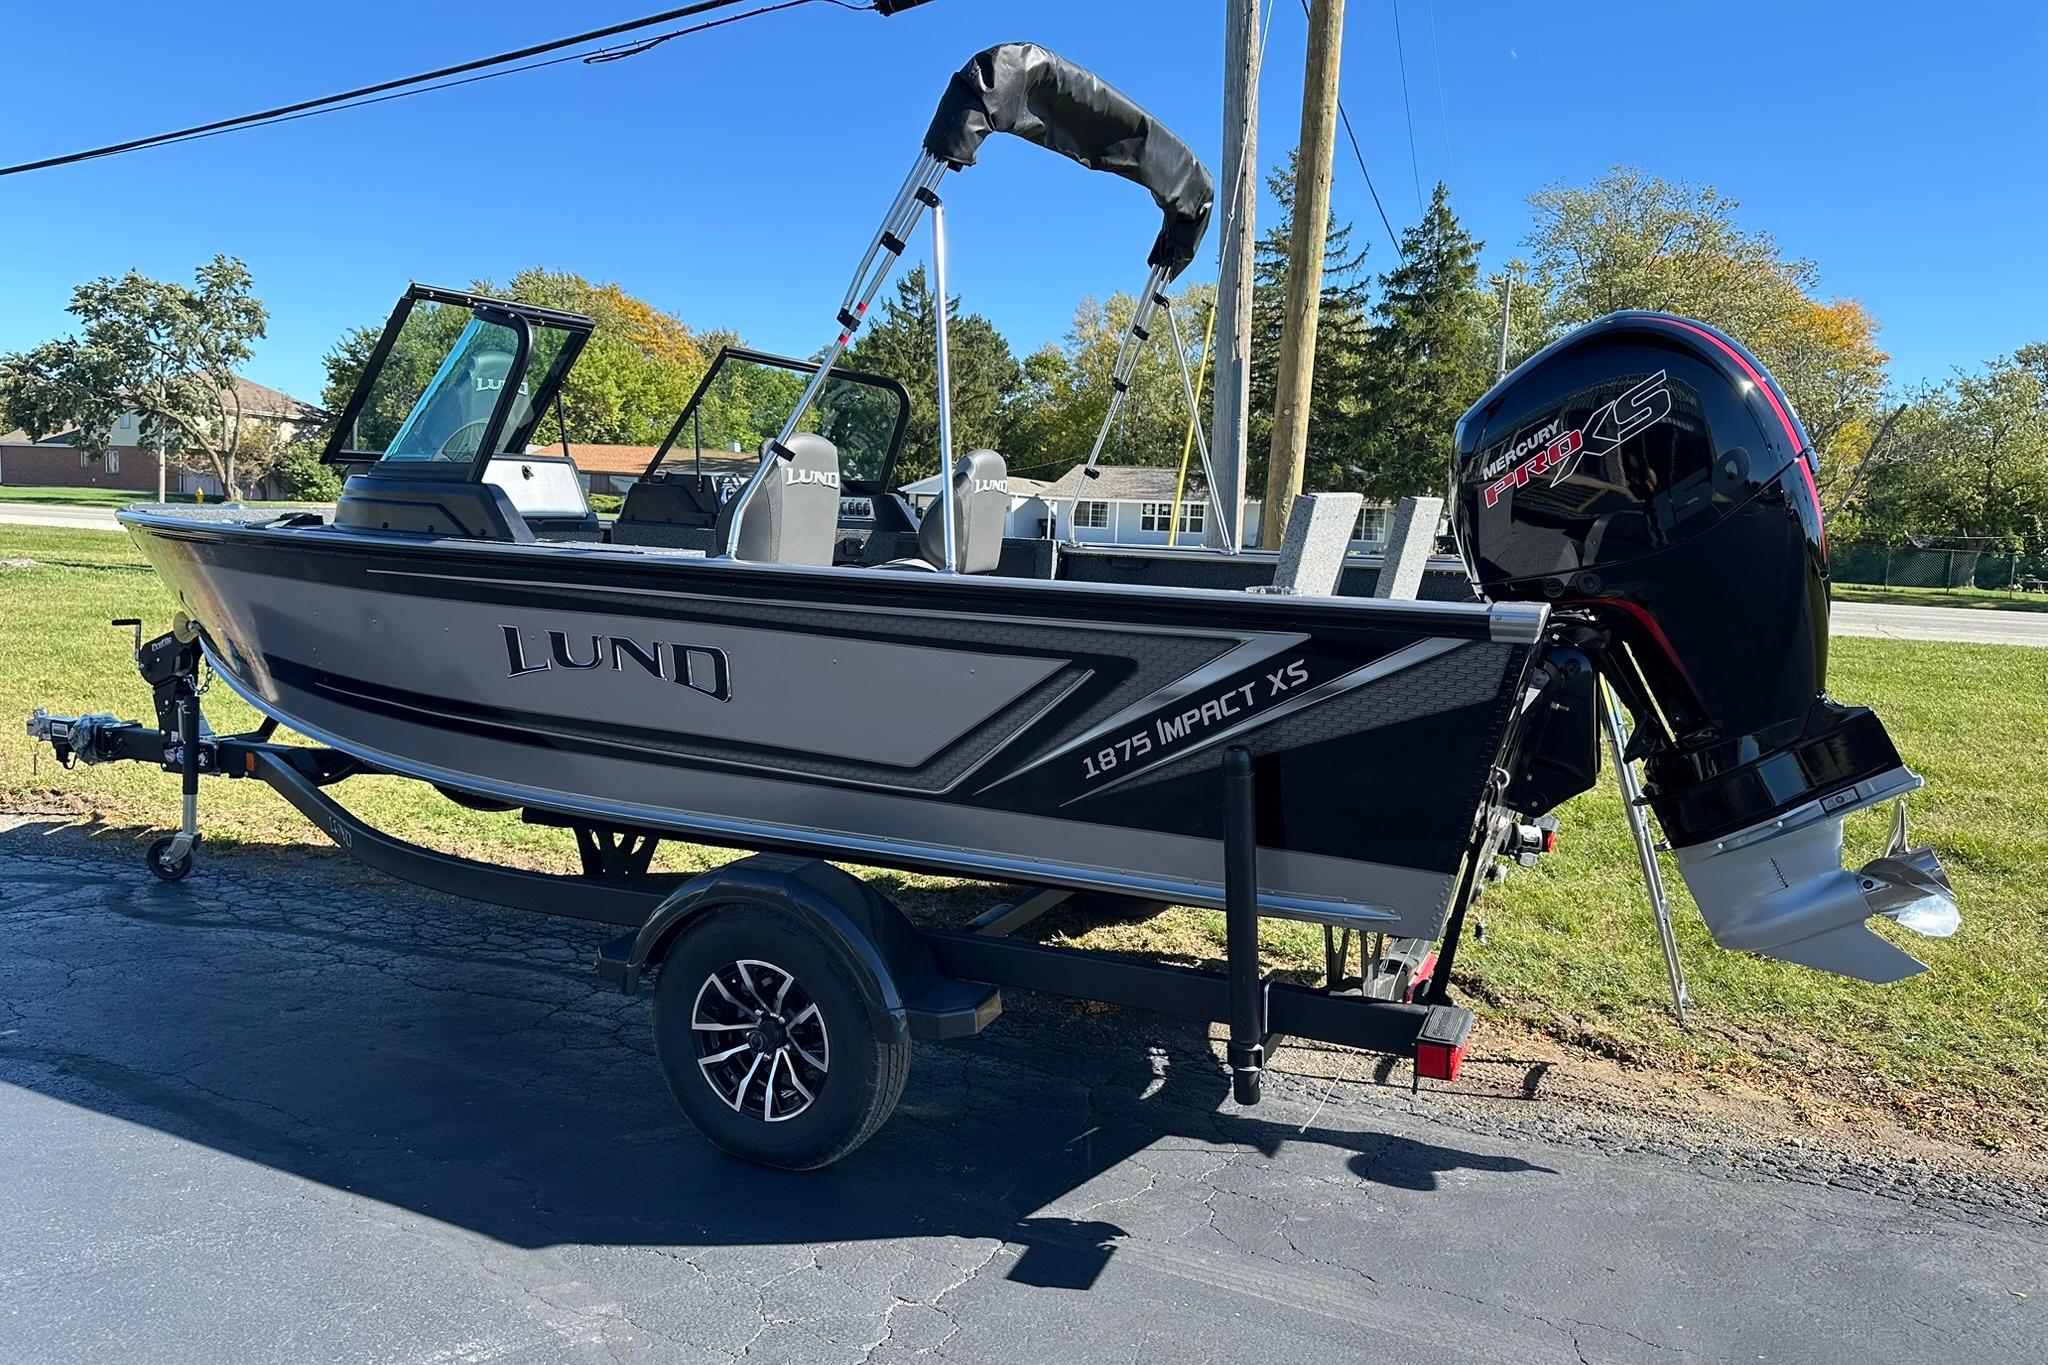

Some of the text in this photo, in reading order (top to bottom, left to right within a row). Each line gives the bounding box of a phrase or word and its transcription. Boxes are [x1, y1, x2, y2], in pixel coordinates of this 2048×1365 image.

[476, 377, 529, 396] LUD
[1483, 419, 1560, 481] MERCURY
[786, 467, 839, 489] LUND
[974, 479, 1008, 494] LUND
[498, 624, 732, 703] LUND
[1082, 658, 1309, 779] 1875 IMPACT XS
